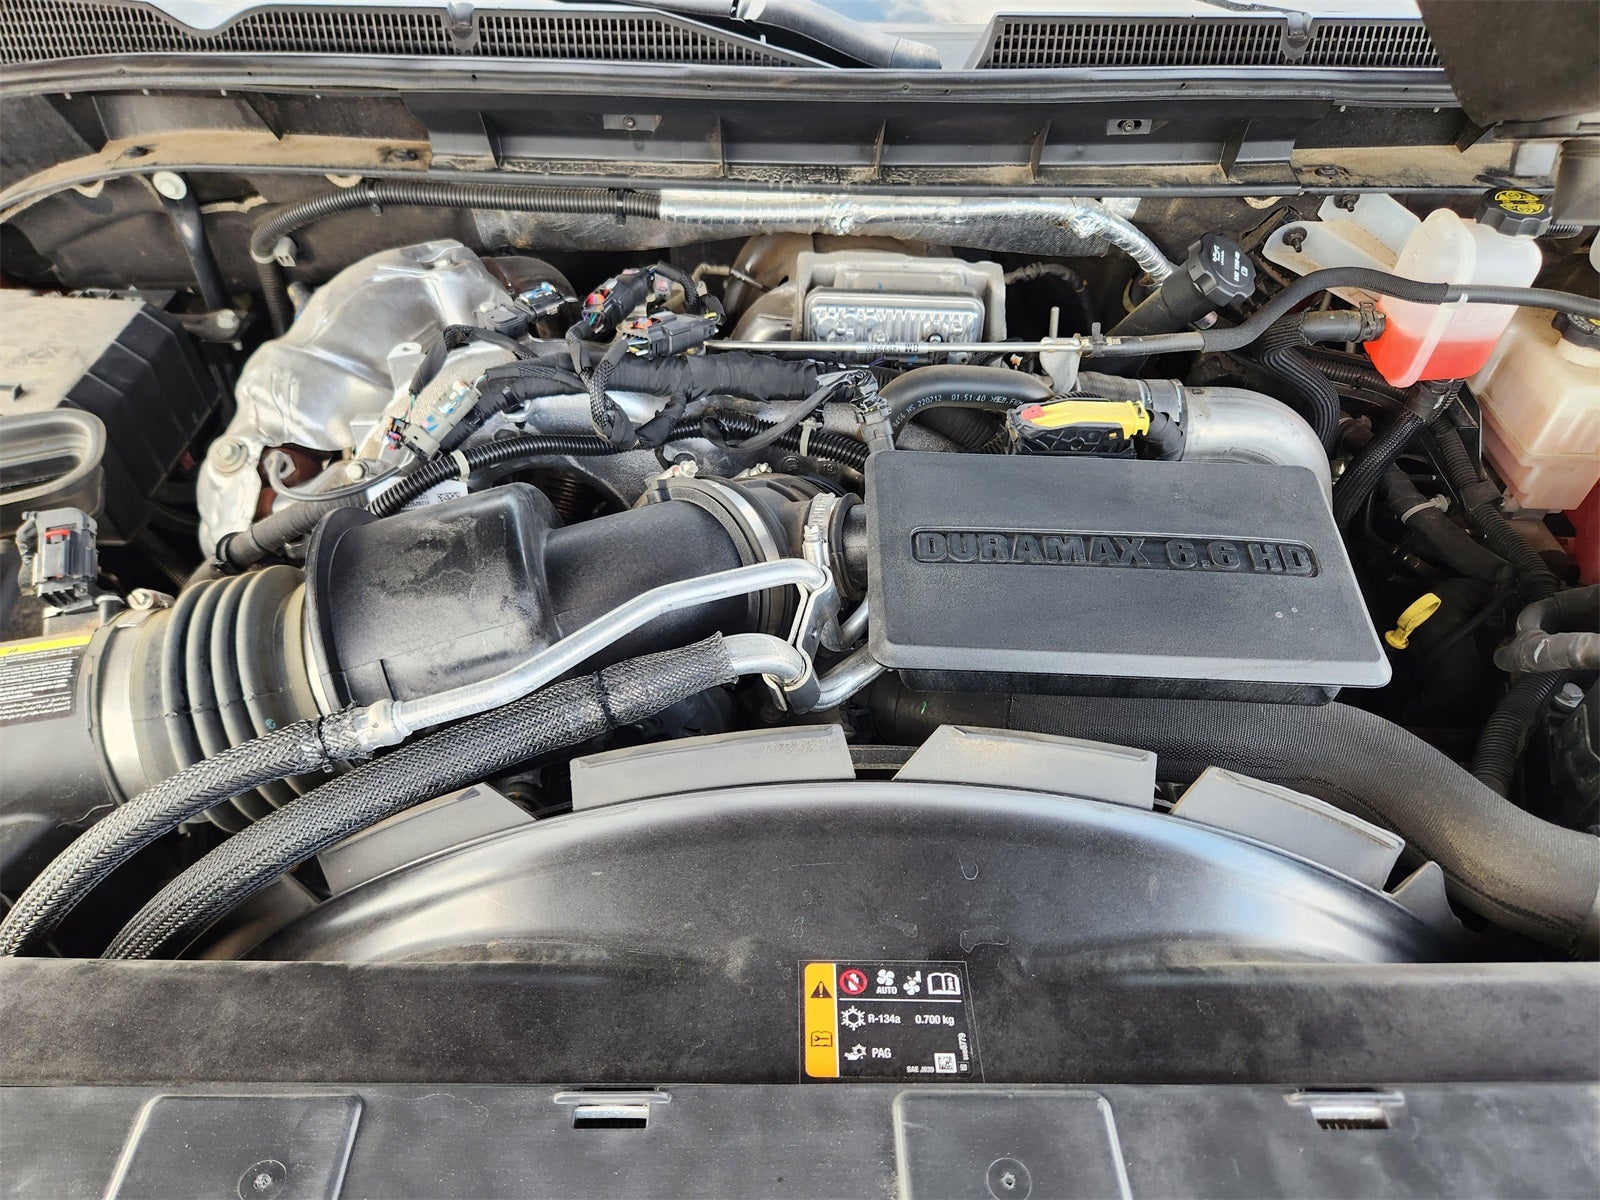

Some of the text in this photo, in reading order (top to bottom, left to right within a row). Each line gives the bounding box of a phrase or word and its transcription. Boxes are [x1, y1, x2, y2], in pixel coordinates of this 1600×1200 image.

[904, 343, 919, 352] GM
[917, 394, 943, 407] 220712
[915, 532, 1314, 576] DURAMAX 6.6 HD
[876, 986, 898, 995] AUTO
[867, 1014, 955, 1026] R-134a 0.700 kg
[872, 1047, 892, 1059] PAG
[906, 1065, 919, 1073] SAE
